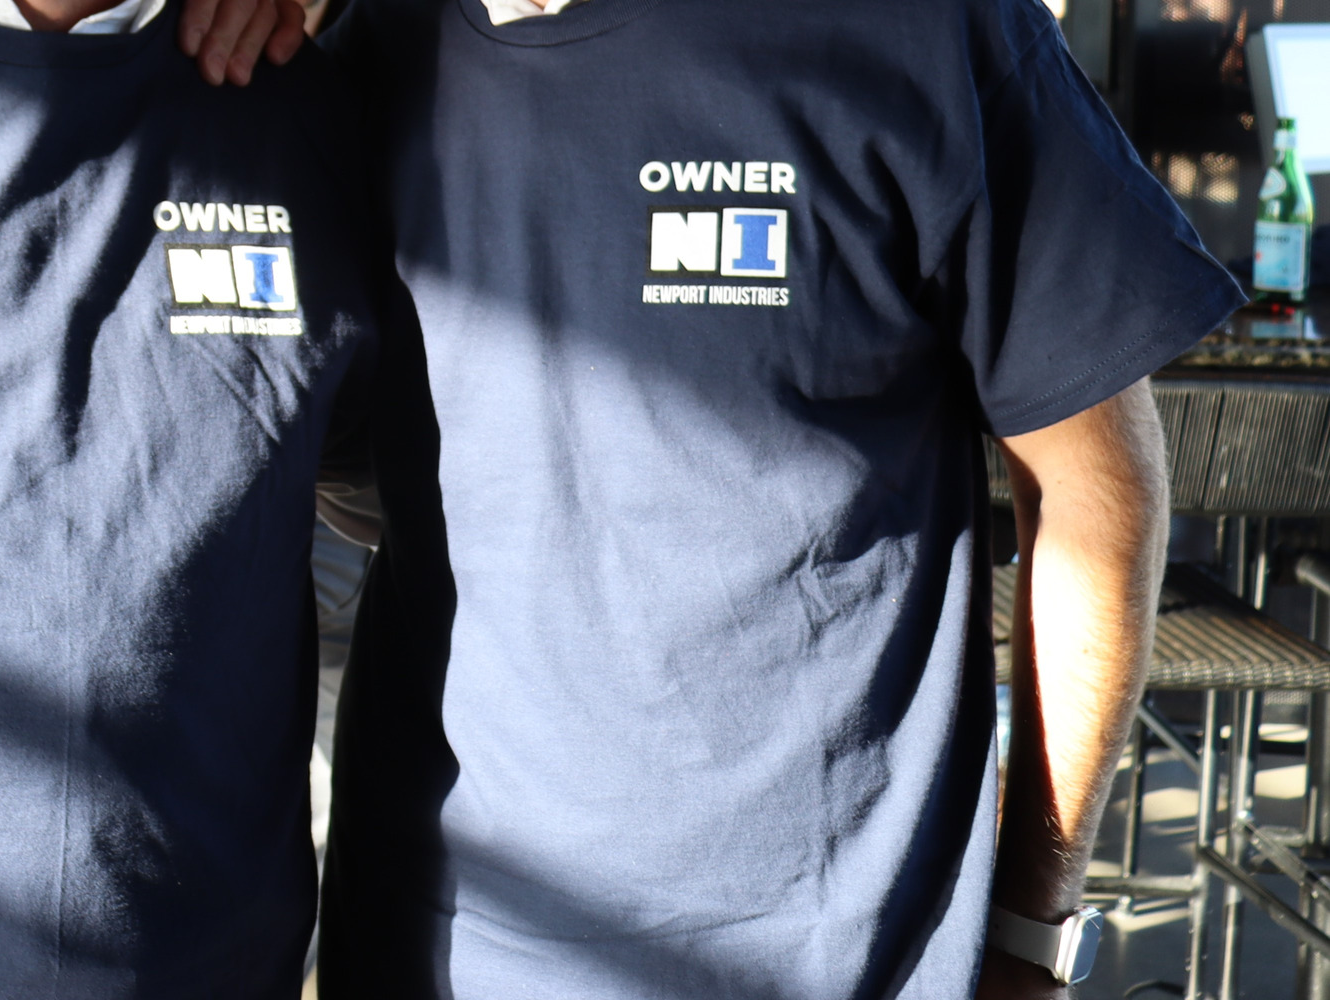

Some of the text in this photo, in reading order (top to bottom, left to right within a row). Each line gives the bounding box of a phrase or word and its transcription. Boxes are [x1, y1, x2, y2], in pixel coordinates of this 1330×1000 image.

[638, 160, 797, 194] OWNER
[153, 200, 292, 233] OWNER
[650, 207, 788, 278] NI
[168, 245, 297, 311] NI
[642, 284, 790, 307] NEWPORT INDUSTRIES
